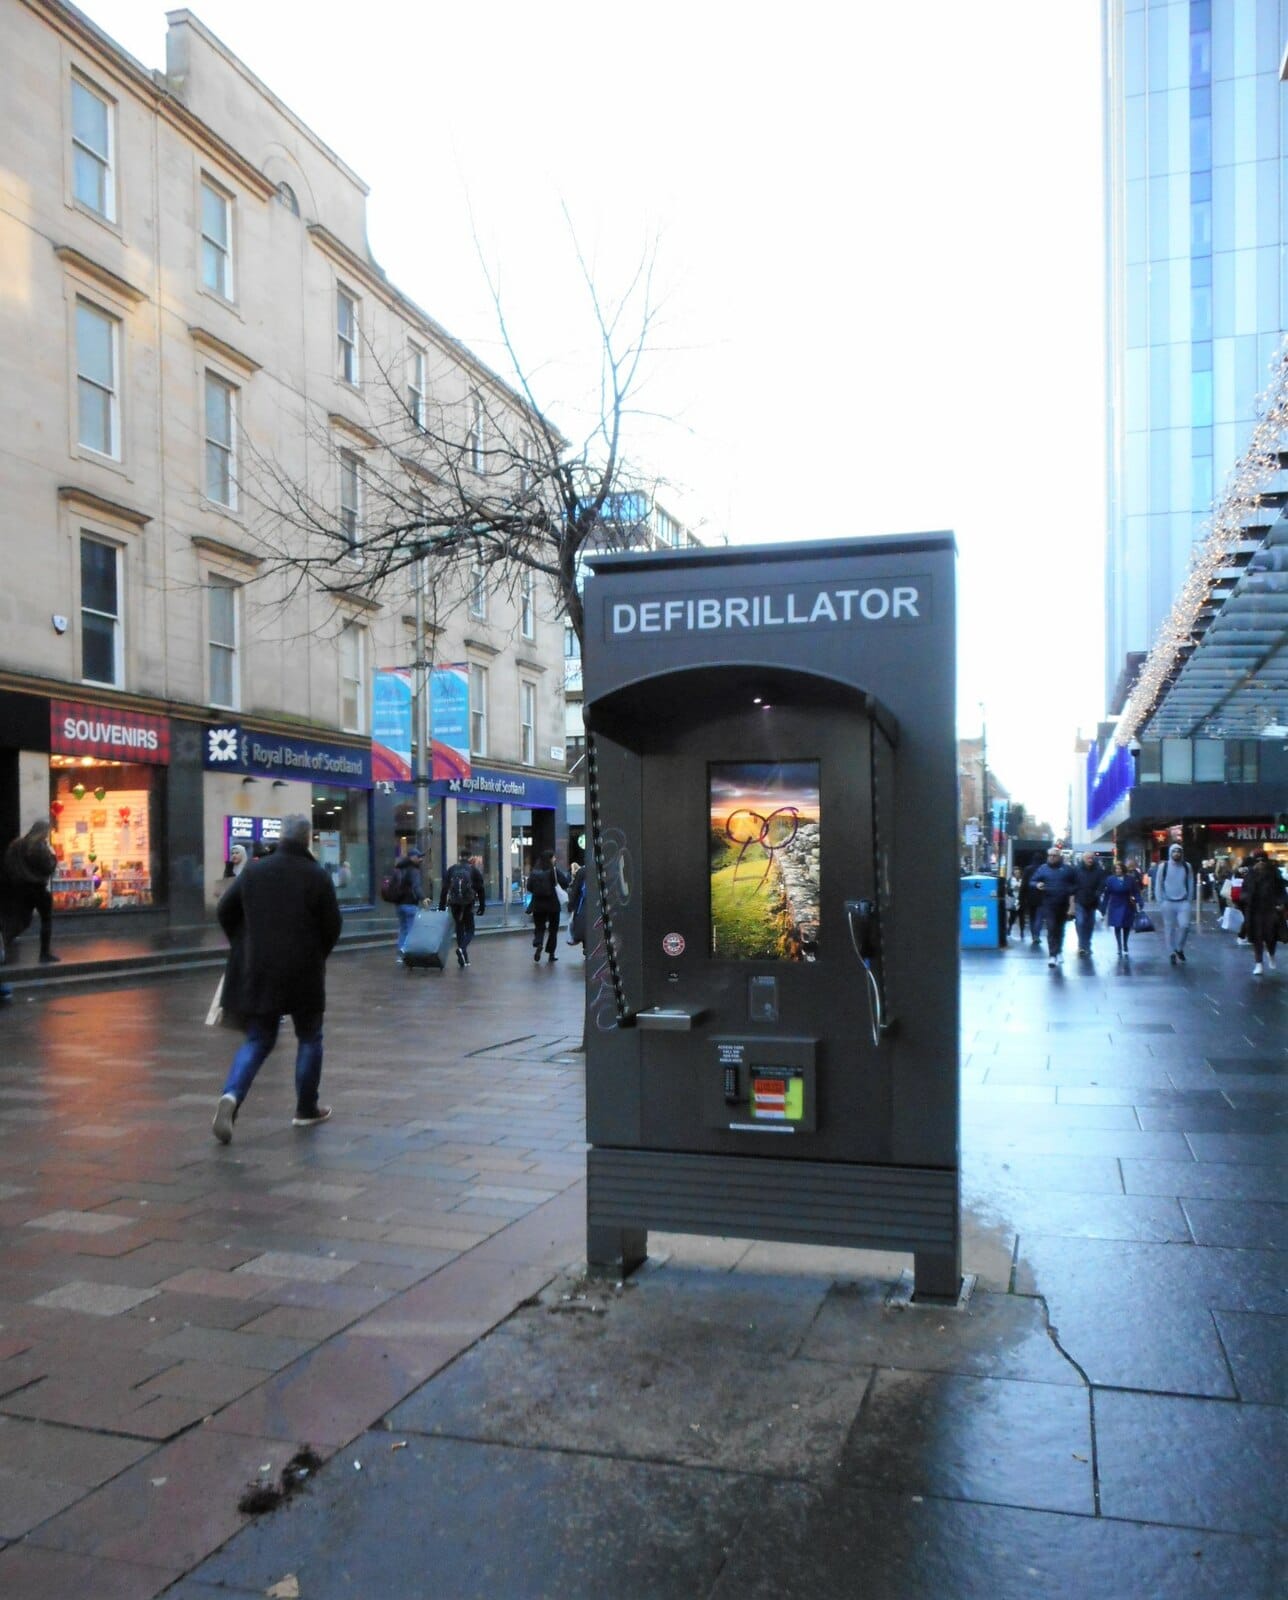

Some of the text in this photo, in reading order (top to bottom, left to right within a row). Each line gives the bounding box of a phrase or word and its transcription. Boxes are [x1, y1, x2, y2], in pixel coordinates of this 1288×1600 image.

[612, 586, 920, 634] DEFIBRILLATOR
[63, 717, 159, 750] SOUVENIRS
[252, 743, 283, 769] Royal
[285, 748, 312, 769] Bank
[313, 752, 323, 770] of
[324, 754, 363, 775] Scotland
[462, 776, 480, 793] Royal
[480, 777, 495, 792] Bank
[502, 780, 525, 795] Scotland
